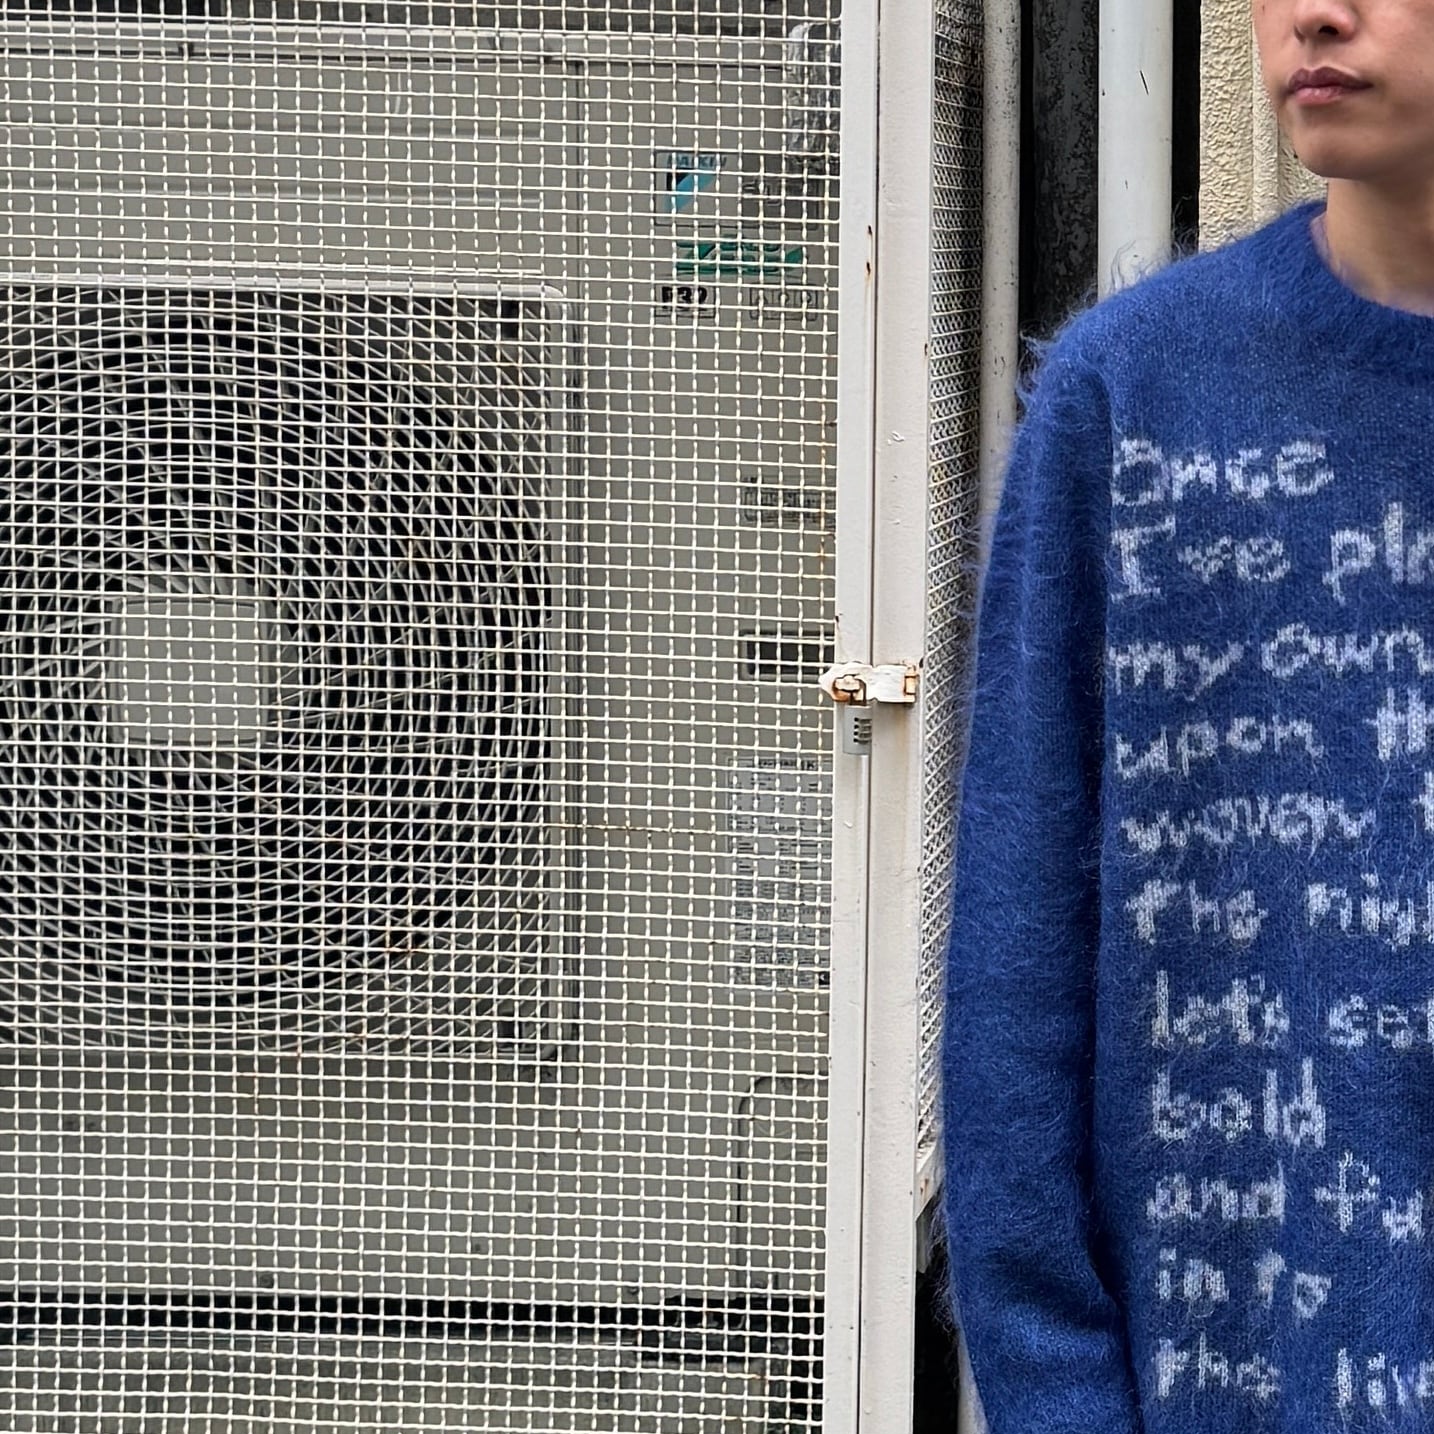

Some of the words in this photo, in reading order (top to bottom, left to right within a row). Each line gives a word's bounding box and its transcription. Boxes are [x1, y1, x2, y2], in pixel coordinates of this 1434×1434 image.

[1111, 440, 1334, 506] Once
[1109, 640, 1244, 701] my
[1115, 716, 1324, 778] upon
[1121, 793, 1376, 851] woven
[1151, 970, 1290, 1049] let's
[1152, 1057, 1326, 1148] bold
[1147, 1160, 1286, 1224] and
